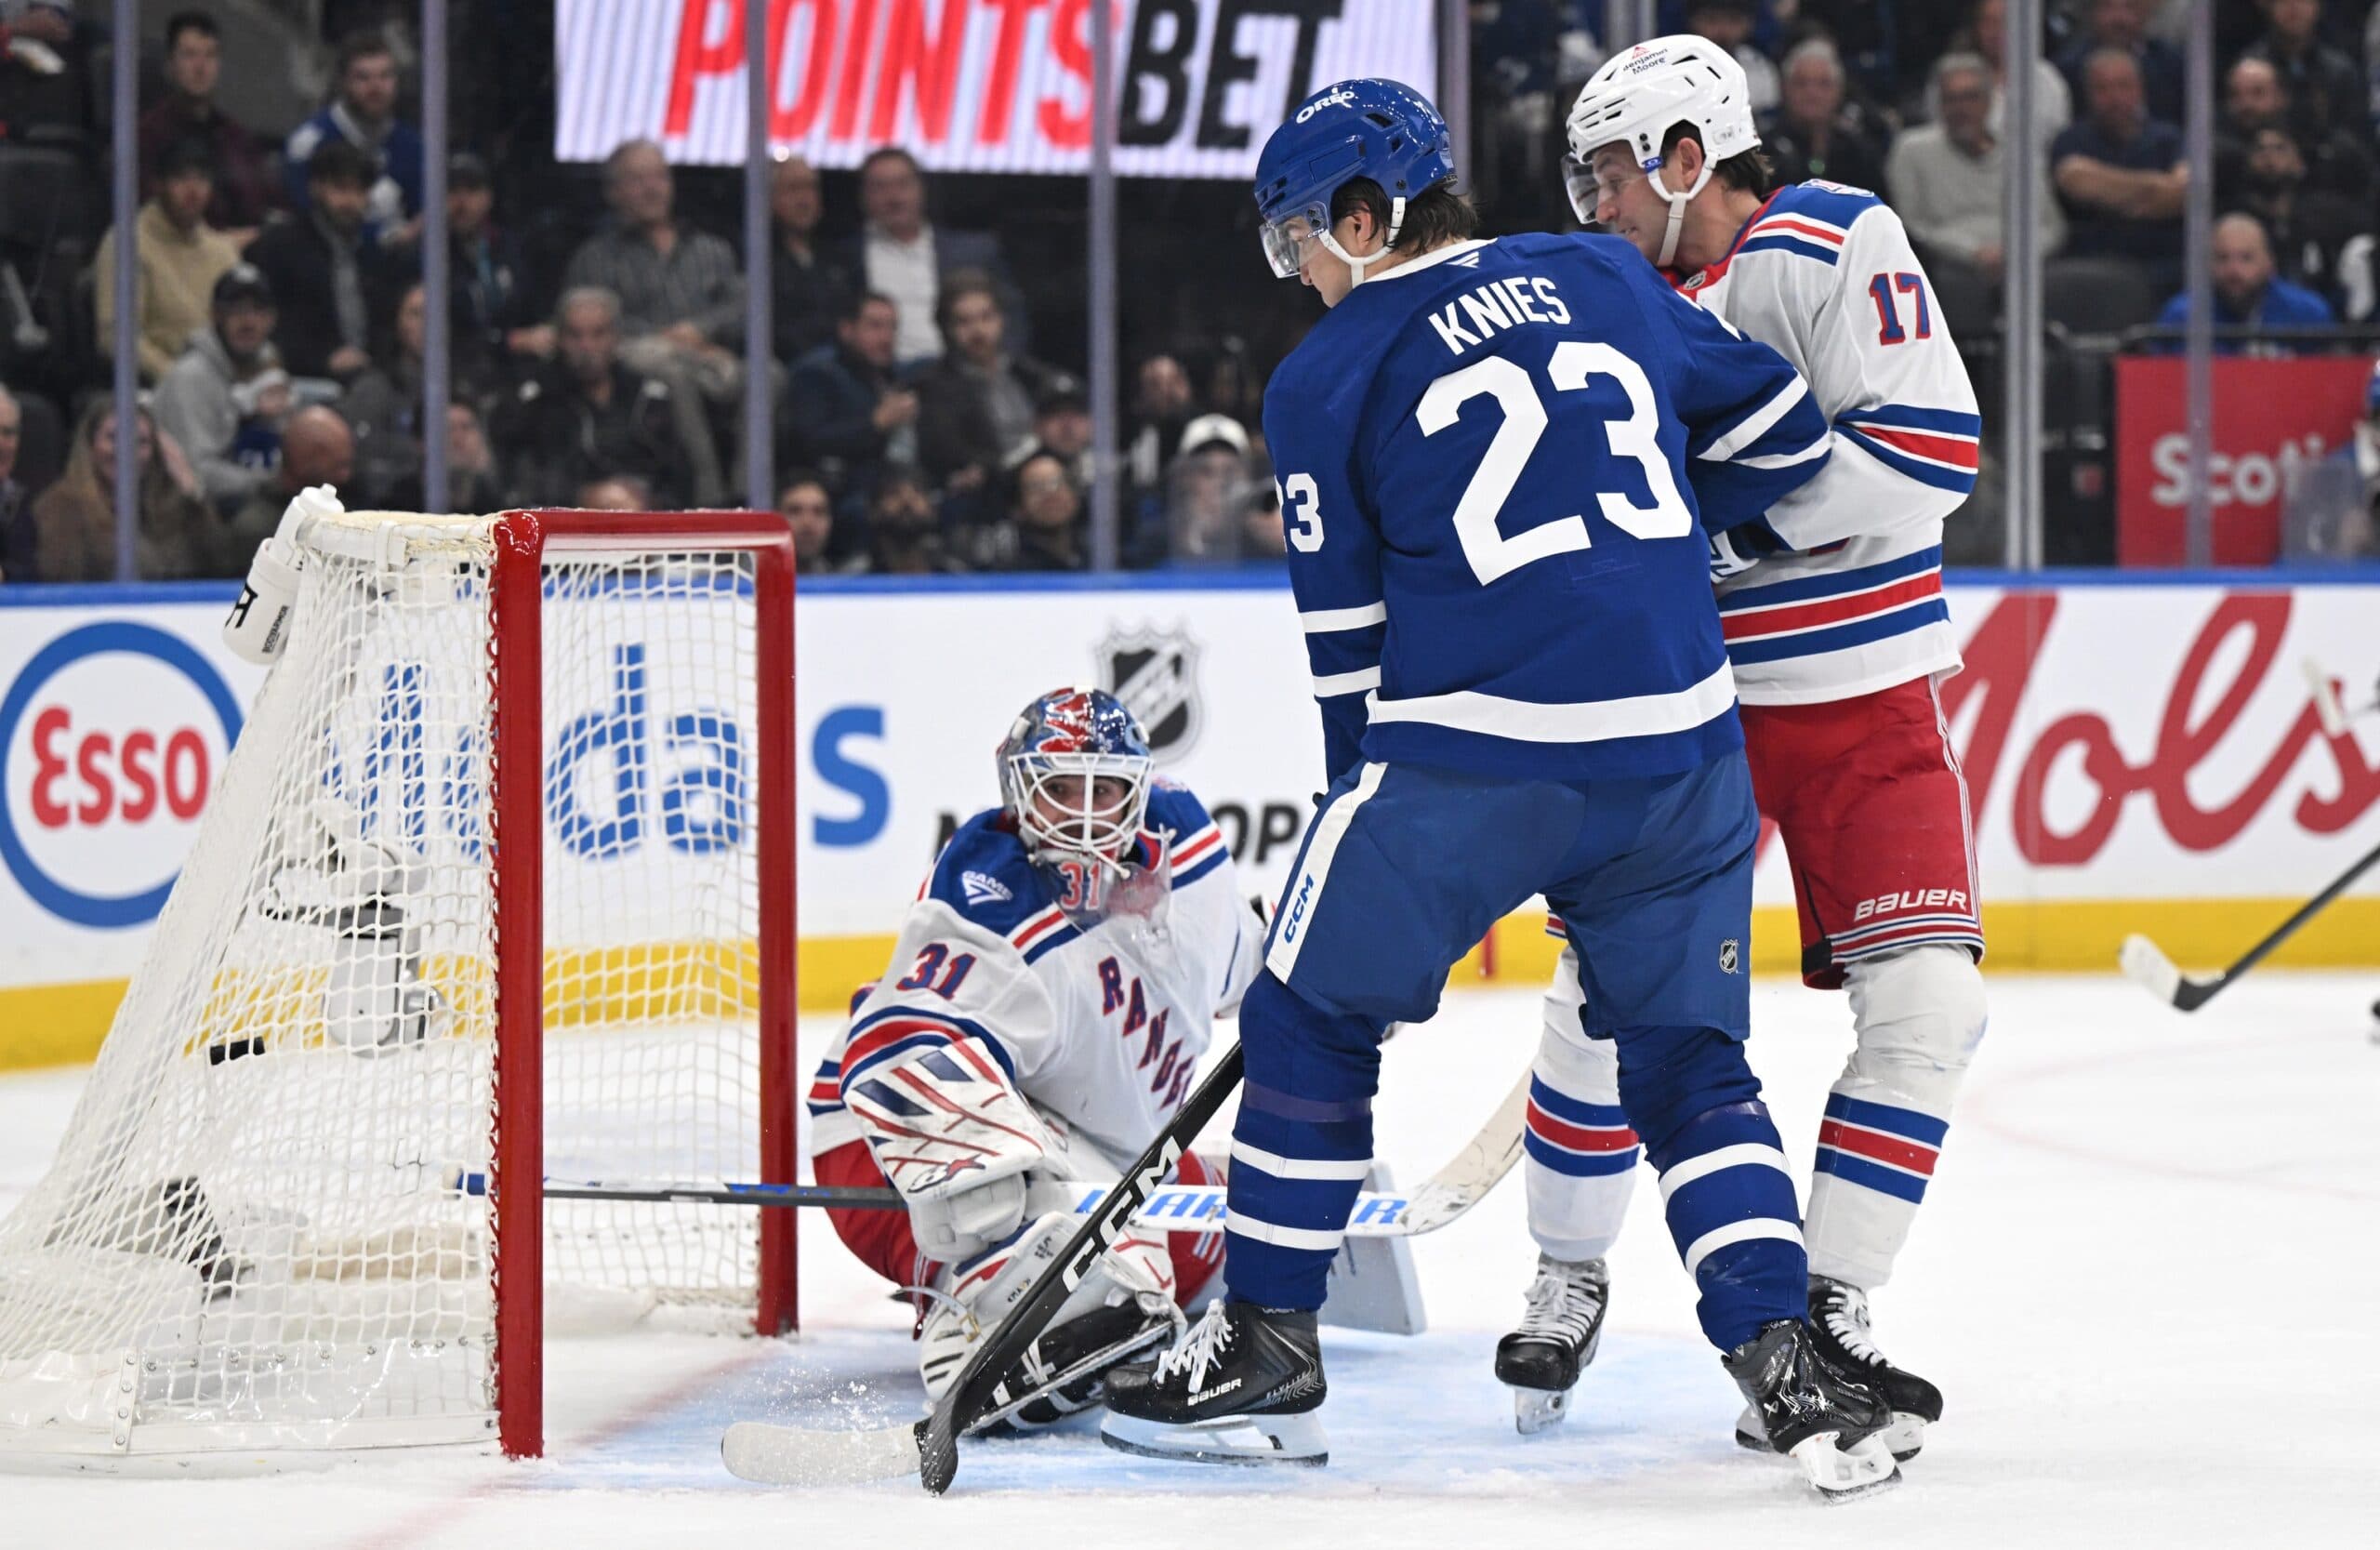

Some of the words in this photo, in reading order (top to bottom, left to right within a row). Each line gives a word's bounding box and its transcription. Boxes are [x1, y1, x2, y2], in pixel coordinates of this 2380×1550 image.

[1632, 57, 1666, 74] Moore
[1296, 91, 1355, 125] OREO
[1428, 277, 1571, 355] KNIES
[1869, 272, 1931, 346] 17
[1415, 341, 1692, 587] 23
[1275, 473, 1325, 552] 3
[32, 707, 210, 828] Esso
[1059, 862, 1101, 910] 31
[1284, 873, 1314, 944] CCM
[1854, 888, 1968, 922] BAUER
[895, 942, 976, 1001] 31
[1098, 955, 1196, 1112] RANGE
[1062, 1135, 1183, 1293] CCM
[1187, 1378, 1242, 1407] BAUER
